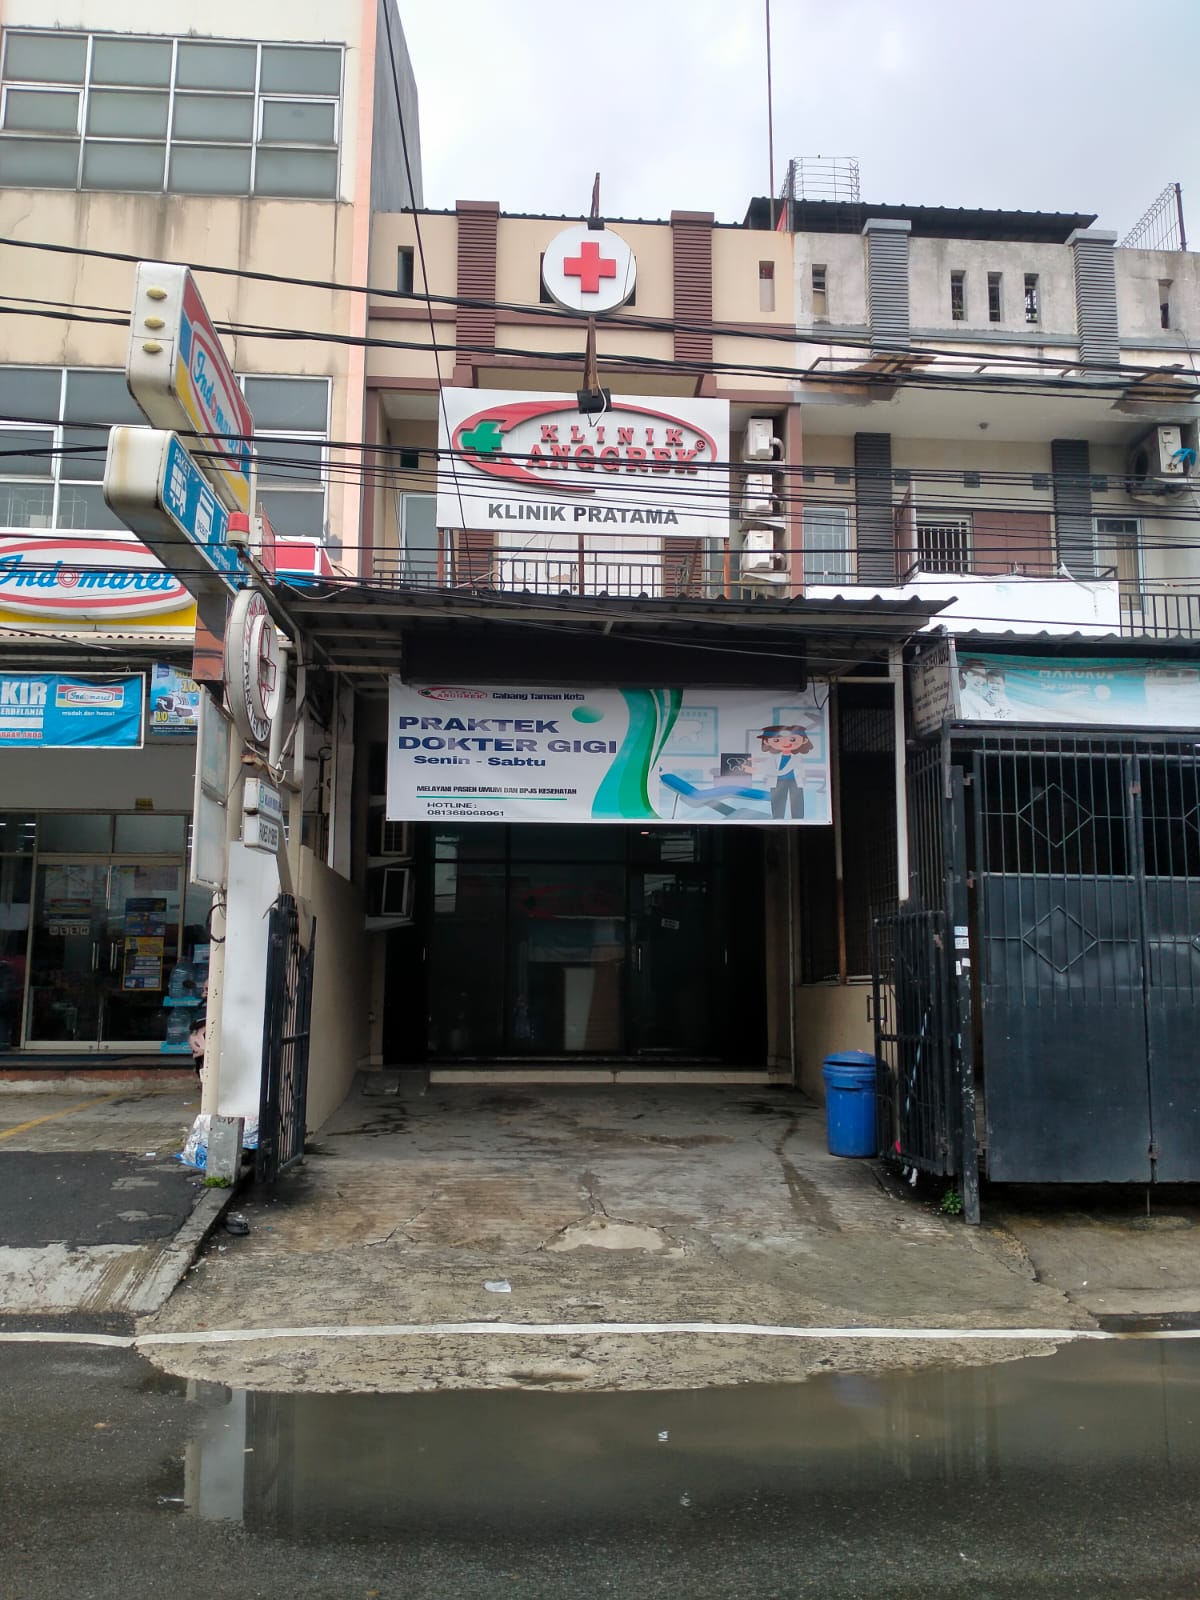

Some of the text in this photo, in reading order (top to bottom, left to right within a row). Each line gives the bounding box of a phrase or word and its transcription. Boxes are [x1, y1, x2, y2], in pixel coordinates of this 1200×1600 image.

[540, 425, 684, 446] KLINIK
[173, 448, 192, 478] PAKET
[526, 444, 698, 473] ANGGREK
[488, 503, 679, 525] KLINIK PRATAMA
[0, 554, 175, 591] Indomaret
[492, 692, 585, 701] Cabang Taman Kota
[399, 716, 560, 733] PRAKTEK
[398, 736, 617, 753] DOKTER GIGI
[414, 755, 471, 765] Senin
[487, 756, 546, 767] Sabtu
